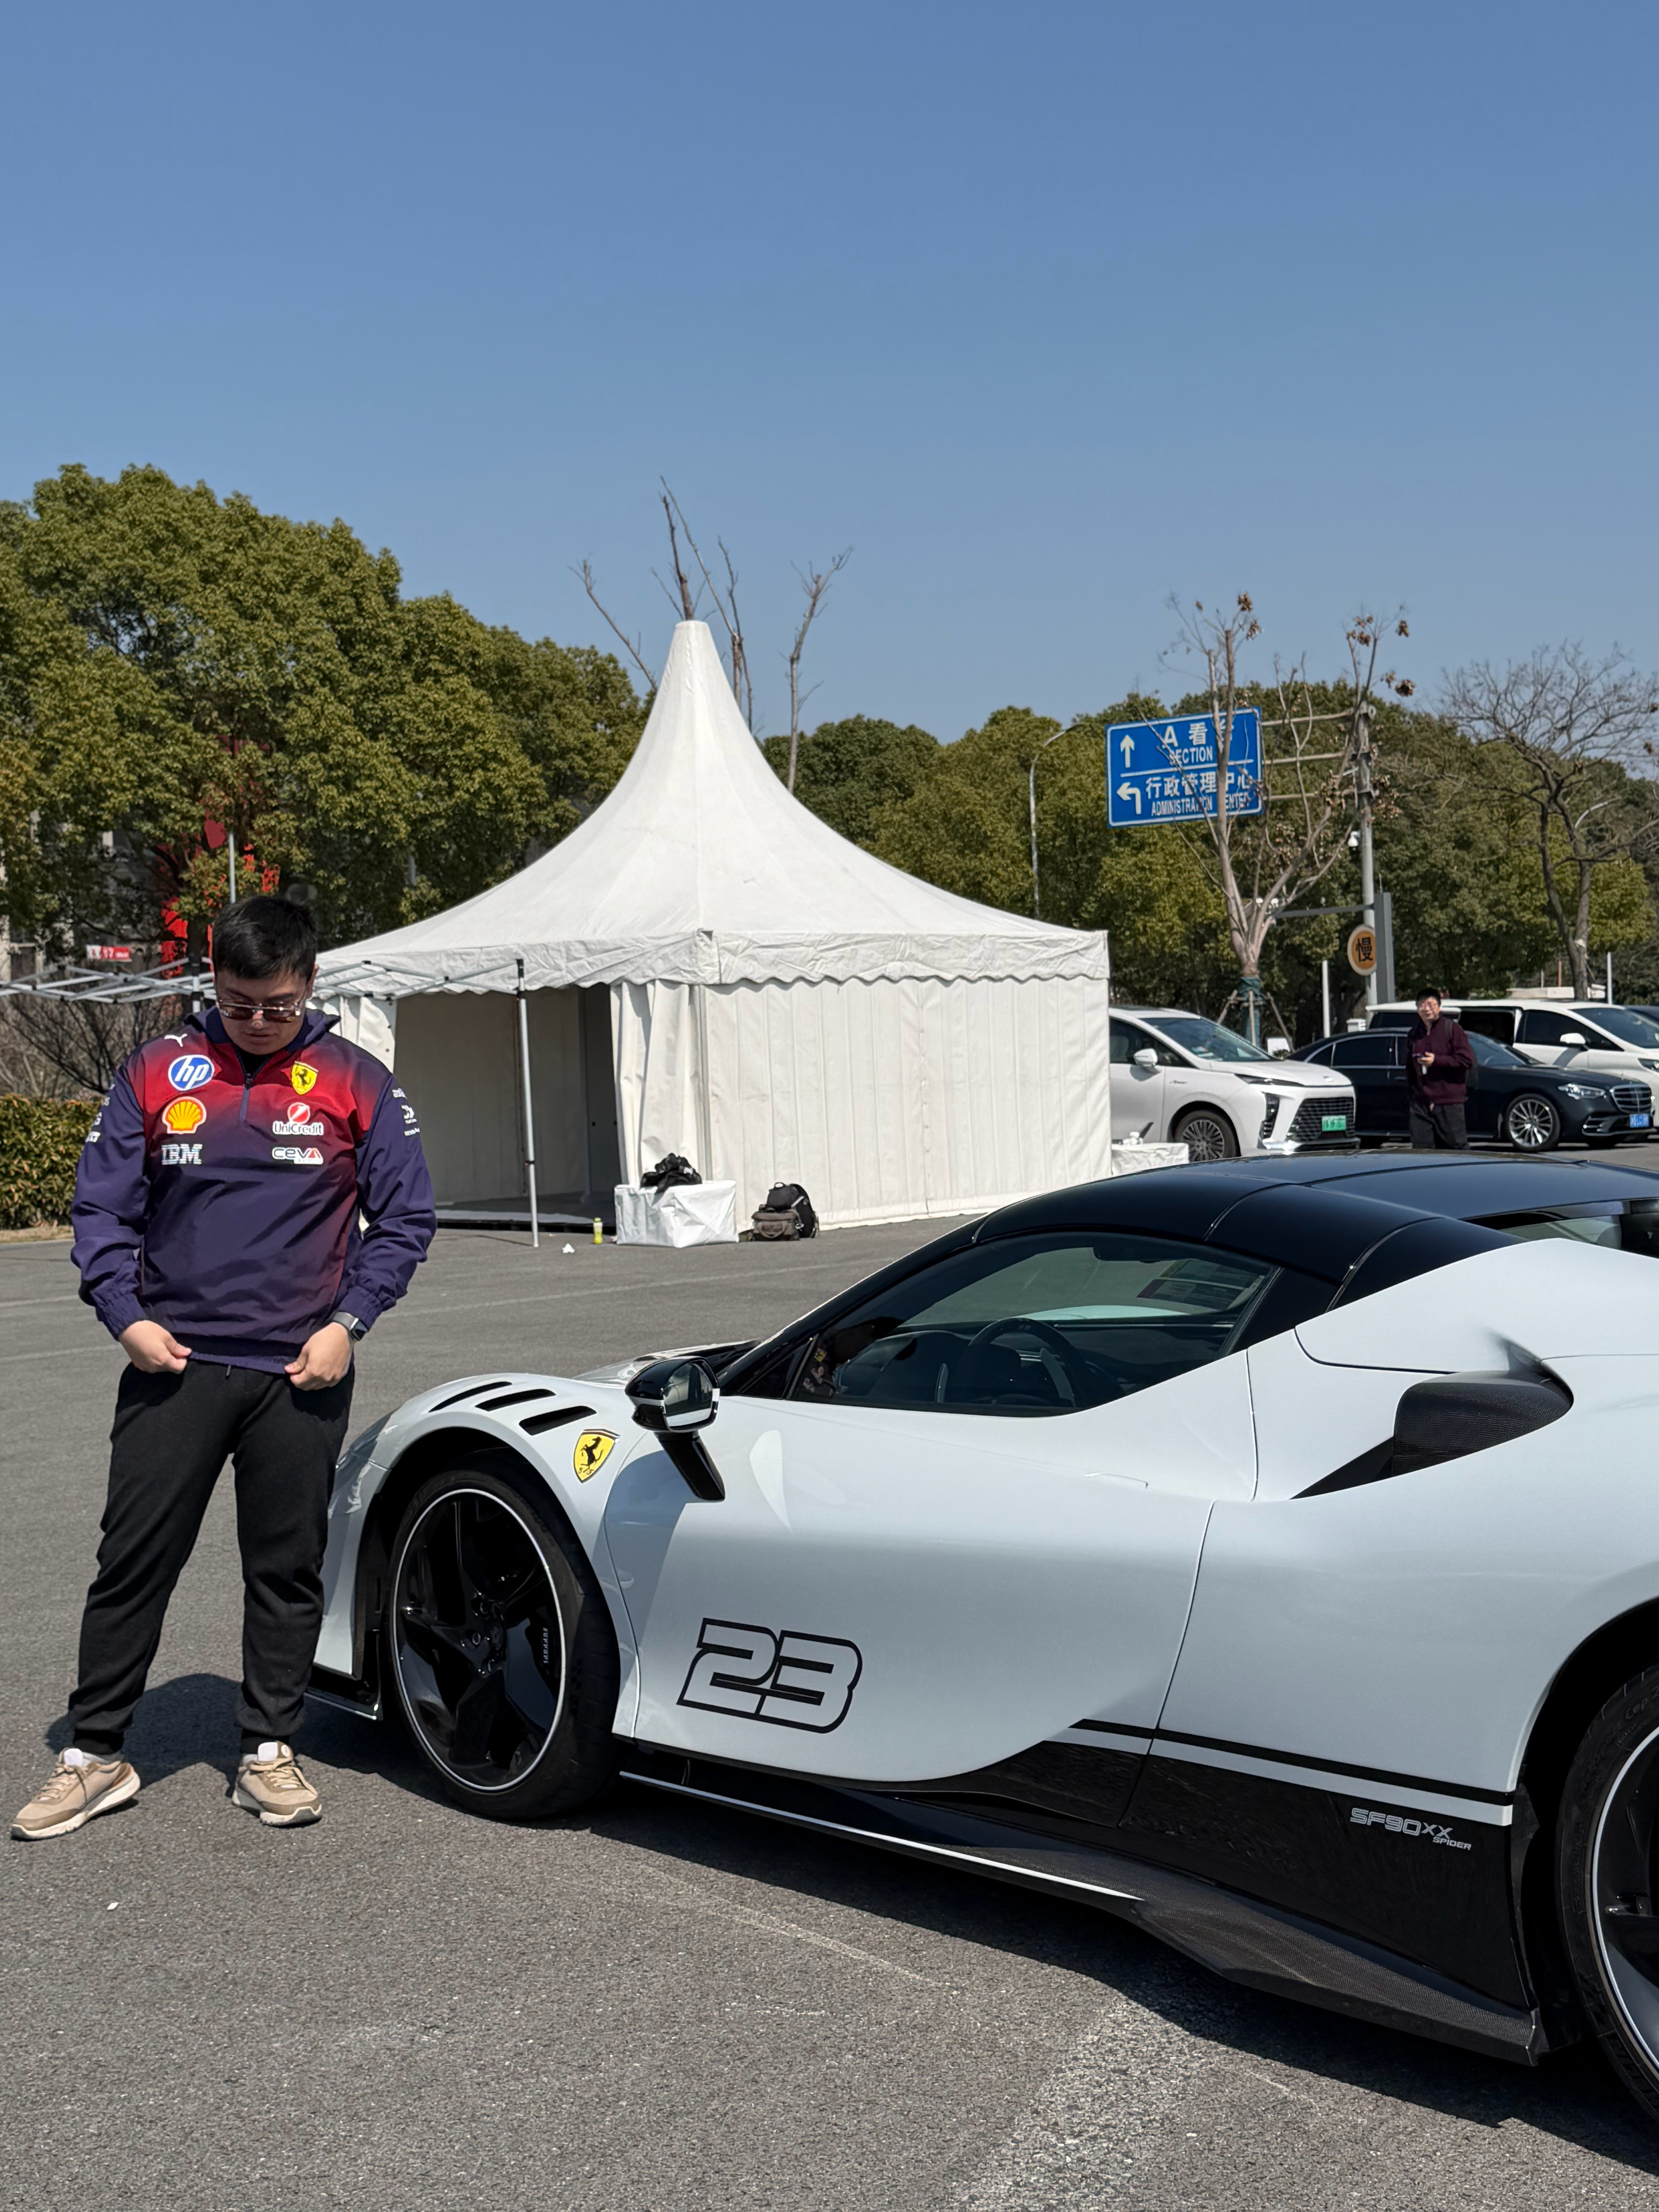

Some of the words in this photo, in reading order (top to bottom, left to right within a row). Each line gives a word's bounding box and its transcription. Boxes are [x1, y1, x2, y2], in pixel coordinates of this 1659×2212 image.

[1170, 746, 1212, 766] SECTION
[1356, 937, 1373, 962] 慢
[174, 1056, 209, 1089] hp
[273, 1122, 323, 1135] UniCredit
[161, 1144, 203, 1165] IBM
[676, 1618, 862, 1734] 23
[1432, 1836, 1472, 1851] SPIDER
